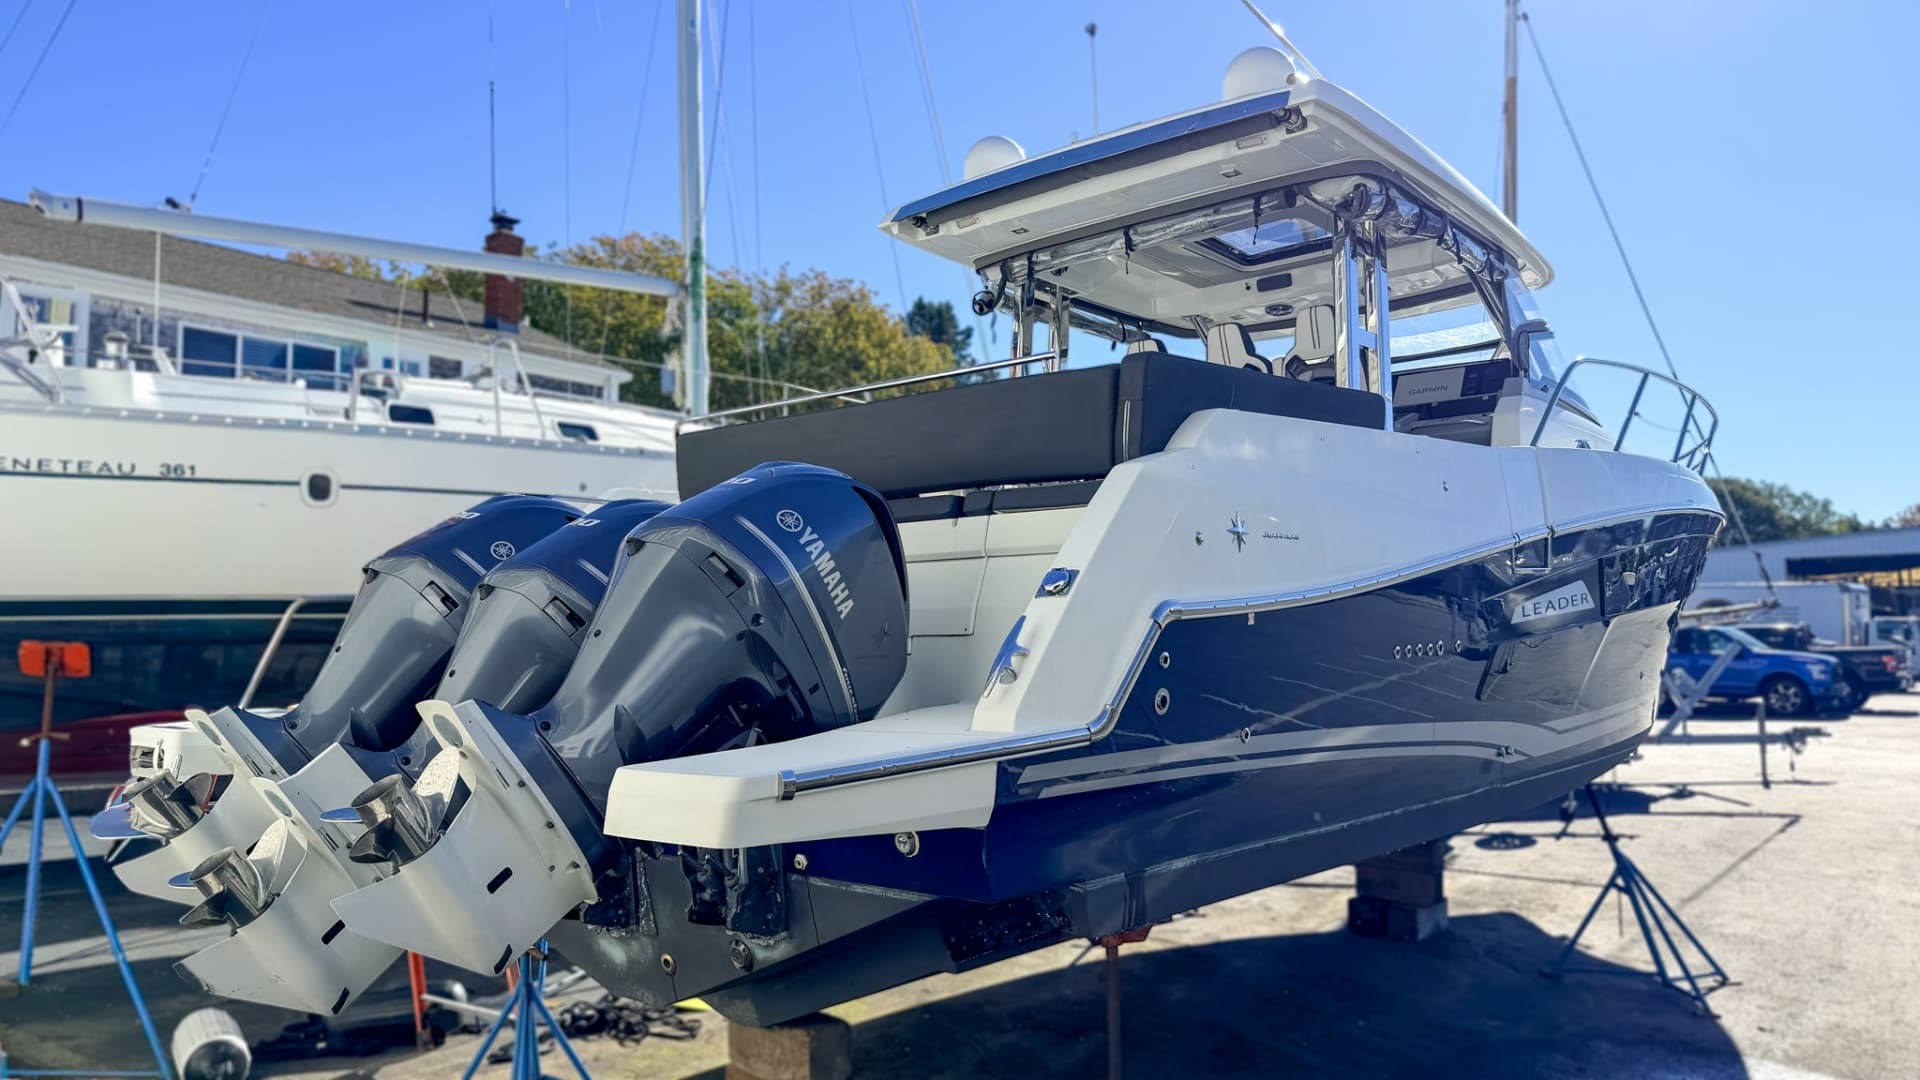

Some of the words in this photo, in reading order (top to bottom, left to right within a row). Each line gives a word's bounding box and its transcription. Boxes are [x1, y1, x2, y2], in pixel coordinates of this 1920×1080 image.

[159, 462, 196, 477] 361
[798, 526, 854, 620] YAMAHA
[1521, 592, 1590, 617] LEADER
